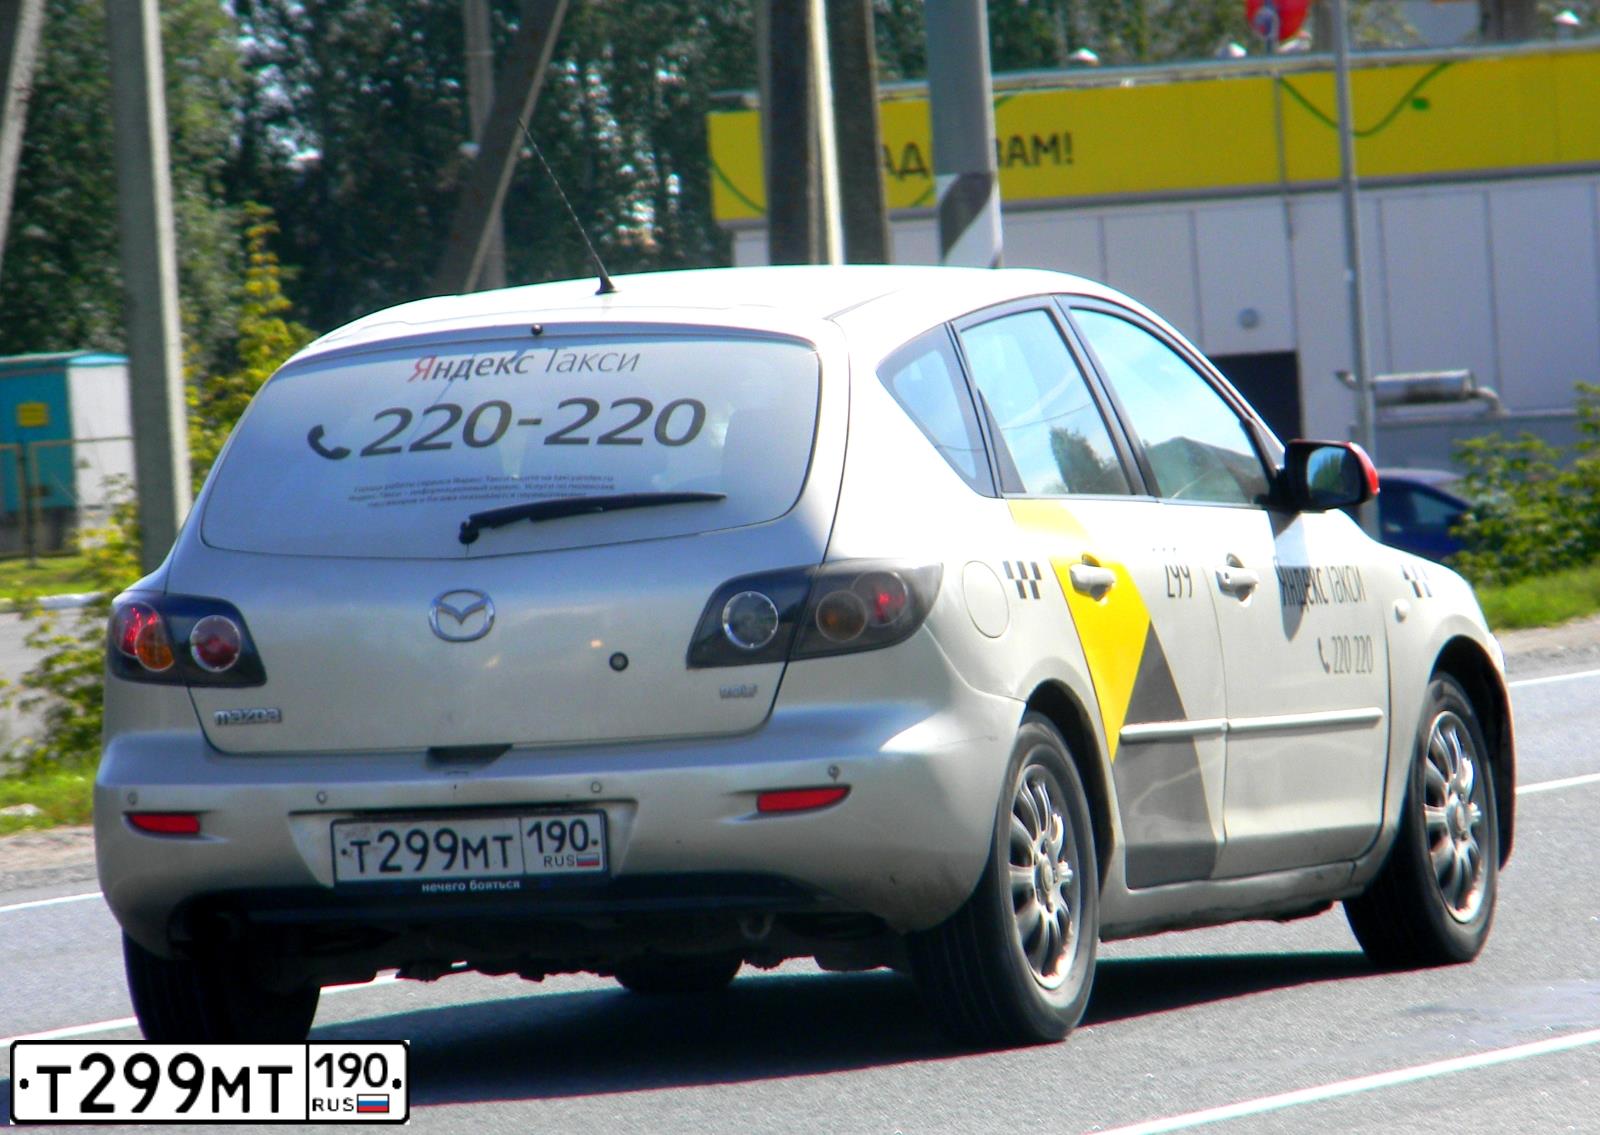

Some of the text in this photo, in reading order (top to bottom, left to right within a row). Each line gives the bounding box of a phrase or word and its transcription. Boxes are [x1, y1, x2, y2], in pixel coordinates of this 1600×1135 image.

[408, 347, 641, 383] Яндекс Такси
[360, 397, 707, 457] 220-220
[1331, 634, 1374, 674] 220 220
[350, 818, 590, 874] Т299МТ 190
[543, 855, 575, 867] RUS
[422, 879, 520, 893] нечего бояться
